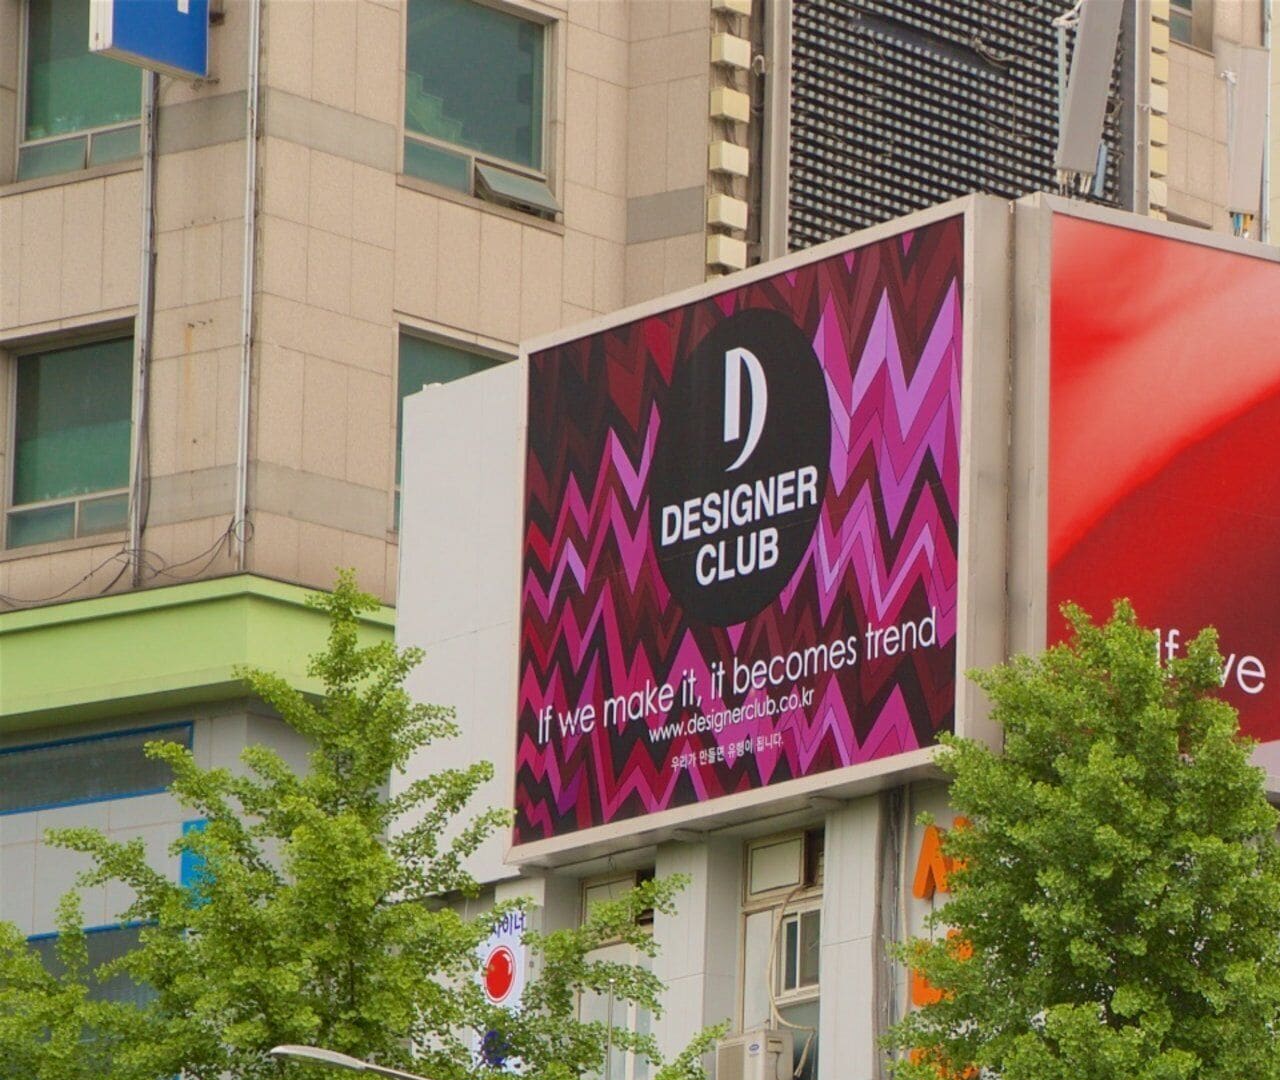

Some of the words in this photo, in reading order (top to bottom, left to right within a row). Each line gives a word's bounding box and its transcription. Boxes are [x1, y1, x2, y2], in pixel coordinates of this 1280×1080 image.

[660, 464, 818, 547] DESIGNER
[696, 528, 780, 586] CLUB
[538, 706, 552, 744] If
[558, 703, 596, 734] we
[604, 679, 674, 728] make
[681, 668, 703, 707] it,
[710, 661, 726, 699] it
[733, 634, 858, 695] becomes
[865, 606, 938, 660] trend
[649, 686, 815, 743] www.designerclub.co.kr
[671, 747, 698, 772] 우리가
[699, 741, 725, 767] 만들면
[727, 735, 754, 762] 유행이
